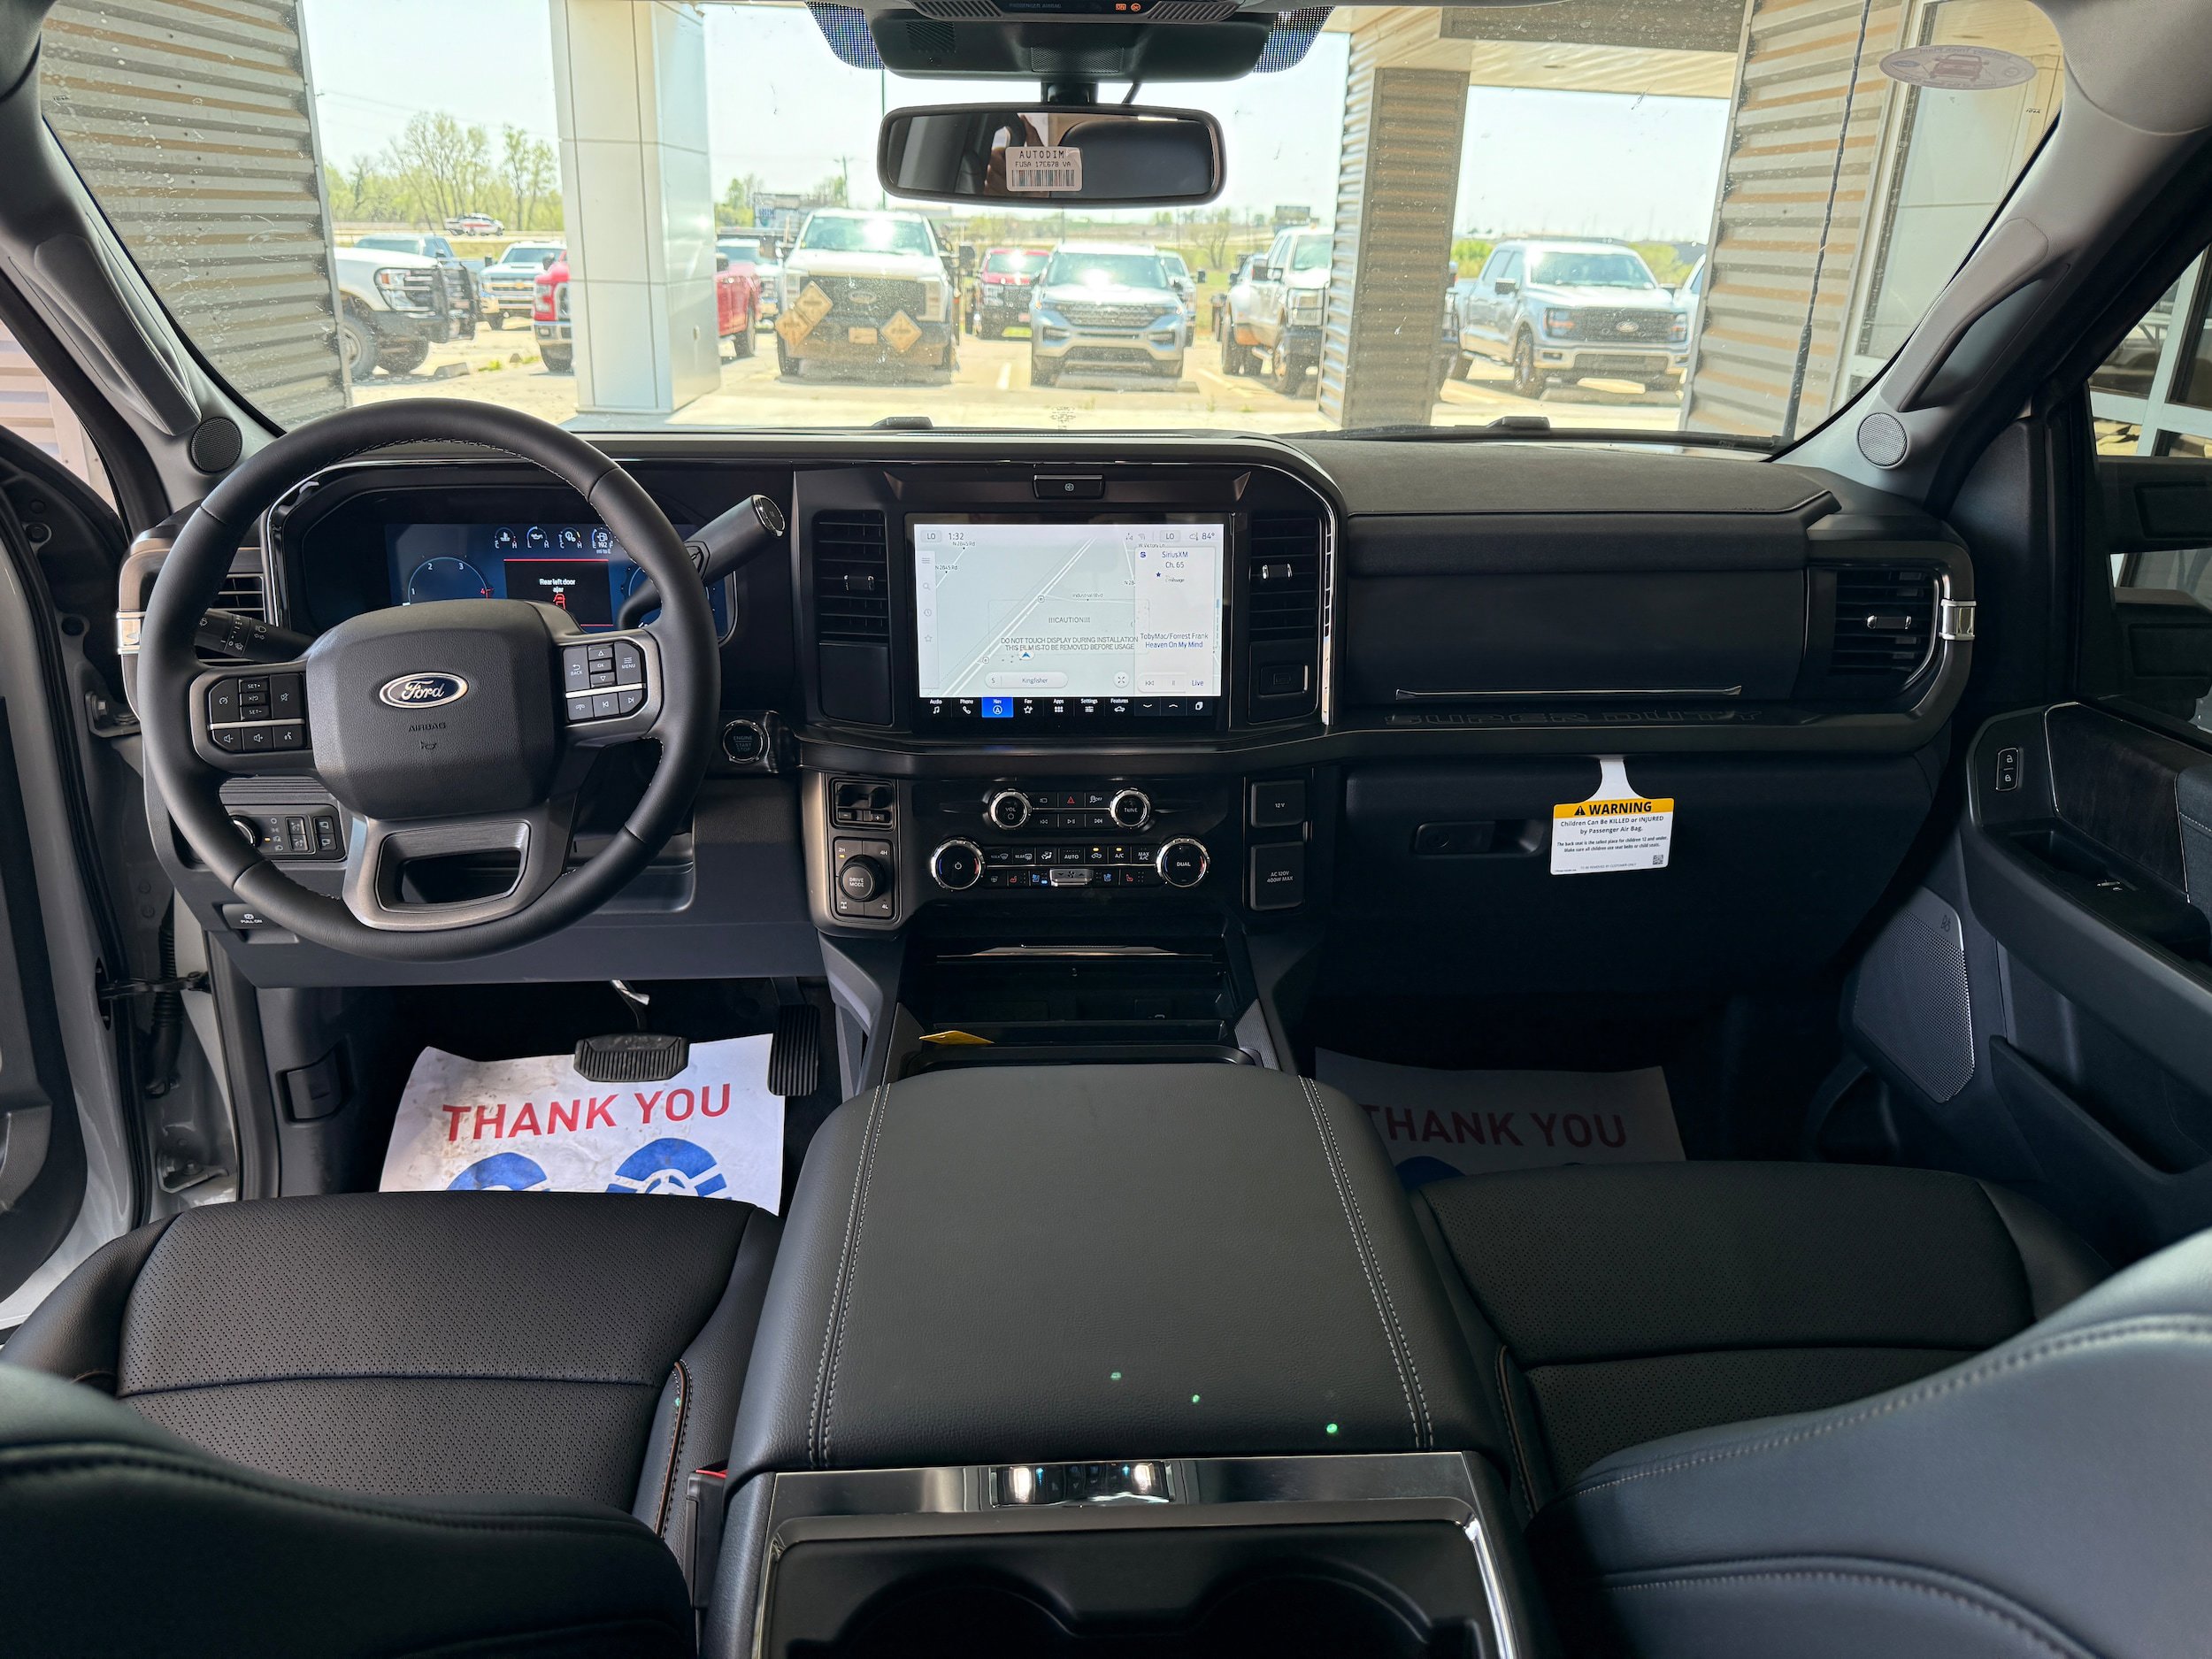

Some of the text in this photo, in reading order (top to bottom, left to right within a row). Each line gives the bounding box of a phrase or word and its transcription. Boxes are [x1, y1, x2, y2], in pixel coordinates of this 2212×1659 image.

[1019, 150, 1064, 159] AUTODIM
[401, 680, 445, 701] Ford
[1384, 710, 1763, 726] SUPER DUTY
[408, 722, 446, 733] AIRBAG
[1589, 802, 1652, 815] WARNING
[442, 1083, 731, 1143] THANK YOU
[1359, 1104, 1626, 1148] THANK YOU
